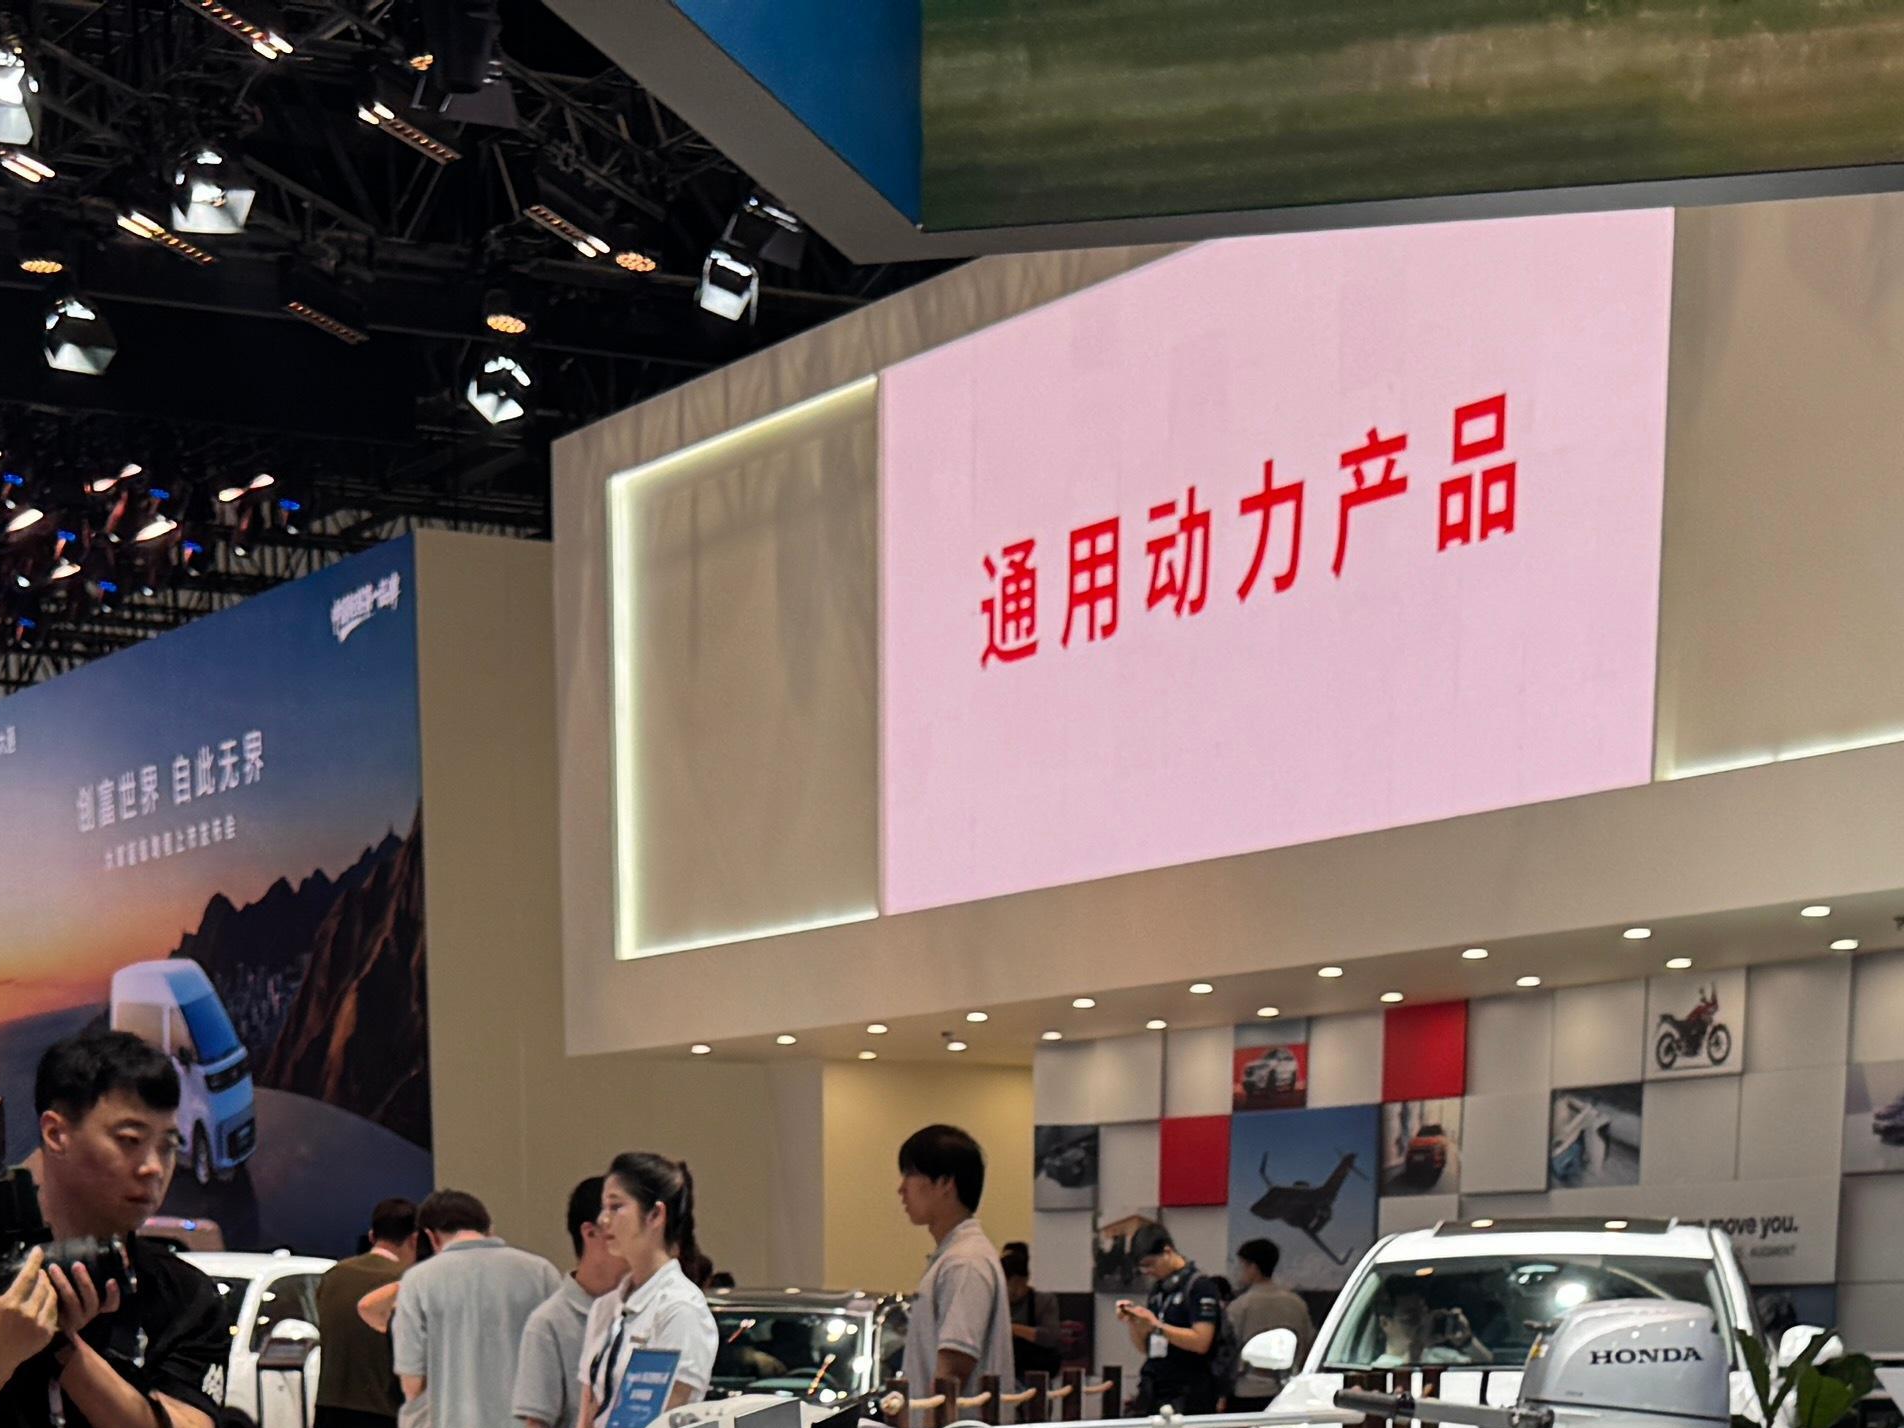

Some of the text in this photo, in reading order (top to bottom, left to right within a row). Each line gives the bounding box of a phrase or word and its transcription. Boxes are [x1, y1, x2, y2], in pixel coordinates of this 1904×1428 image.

[979, 391, 1519, 671] 通用动力产品
[171, 730, 266, 805] 自此无界
[1759, 1215, 1799, 1240] you.
[1589, 1346, 1704, 1366] HONDA
